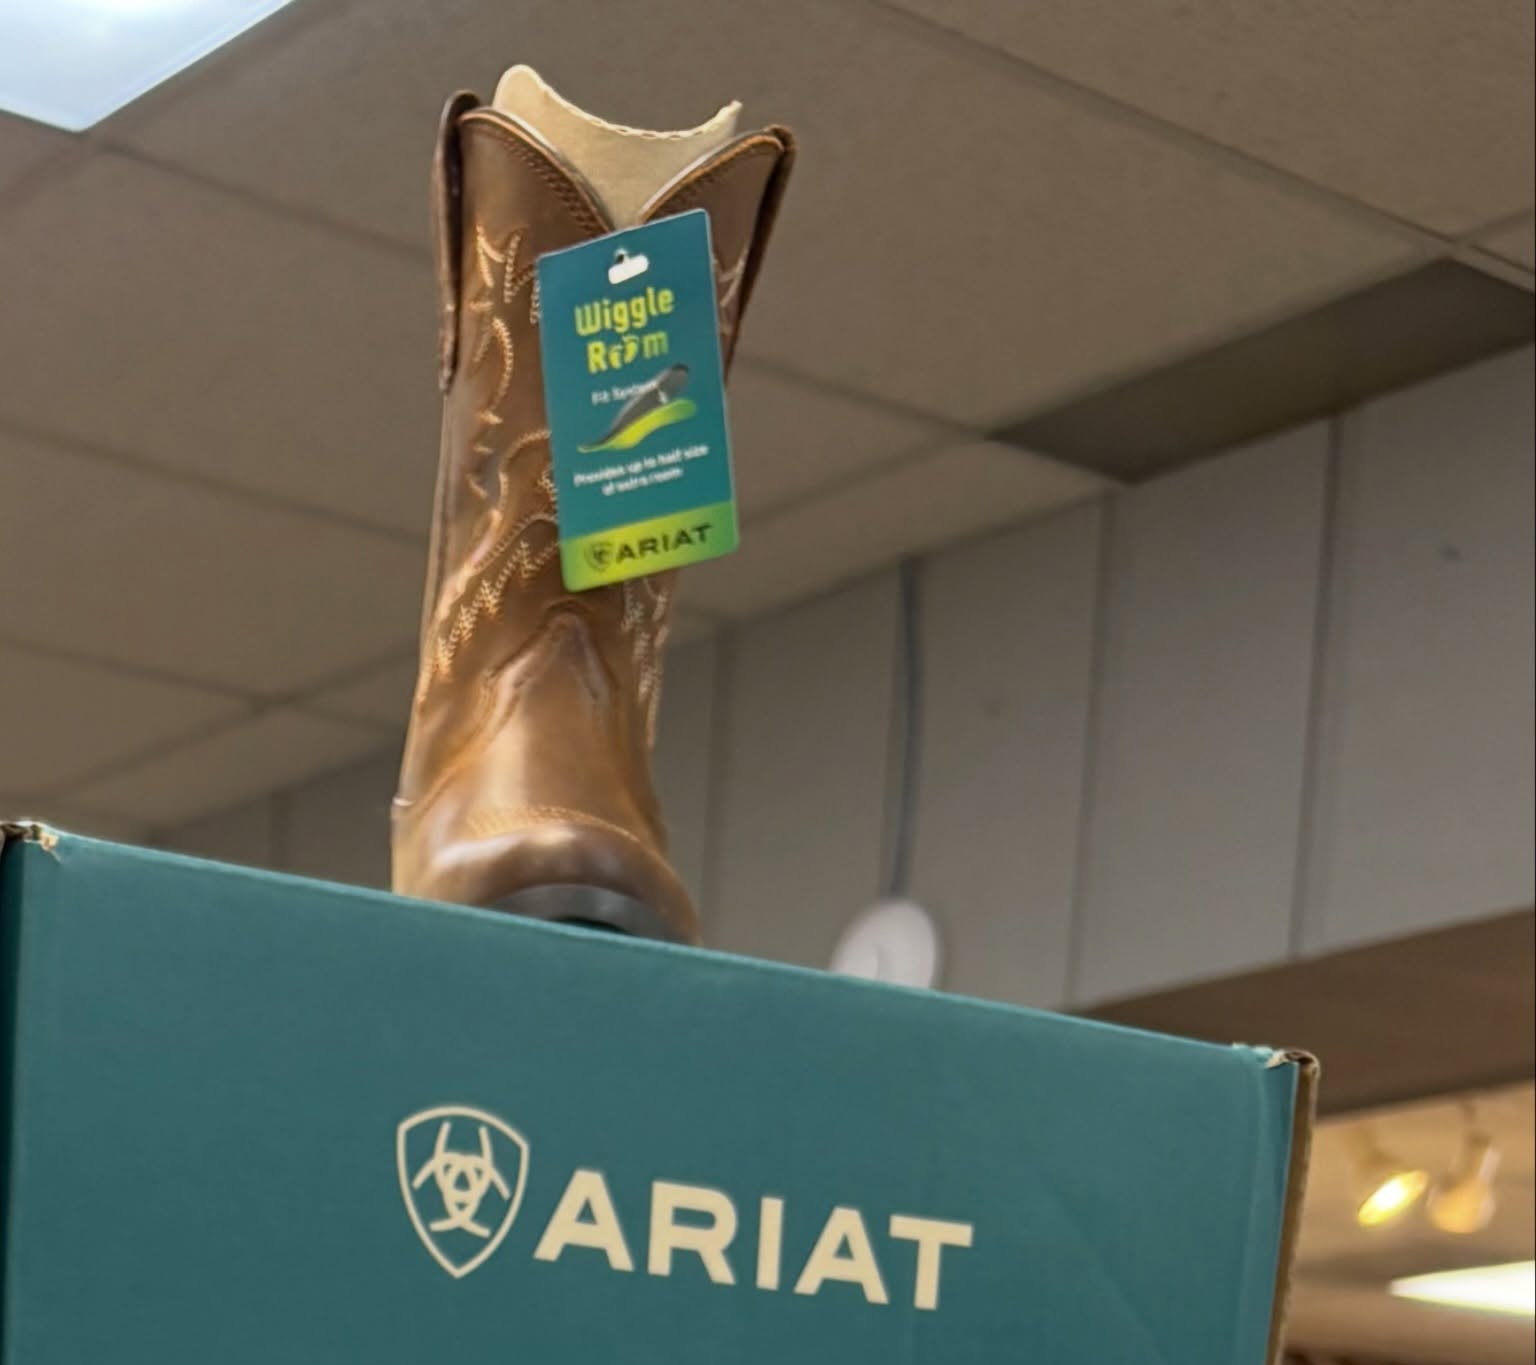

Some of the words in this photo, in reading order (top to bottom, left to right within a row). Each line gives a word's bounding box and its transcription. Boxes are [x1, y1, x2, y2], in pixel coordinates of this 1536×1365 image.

[574, 287, 674, 336] Wiggle
[615, 523, 713, 566] ARIAT
[534, 1169, 973, 1310] ARIAT
